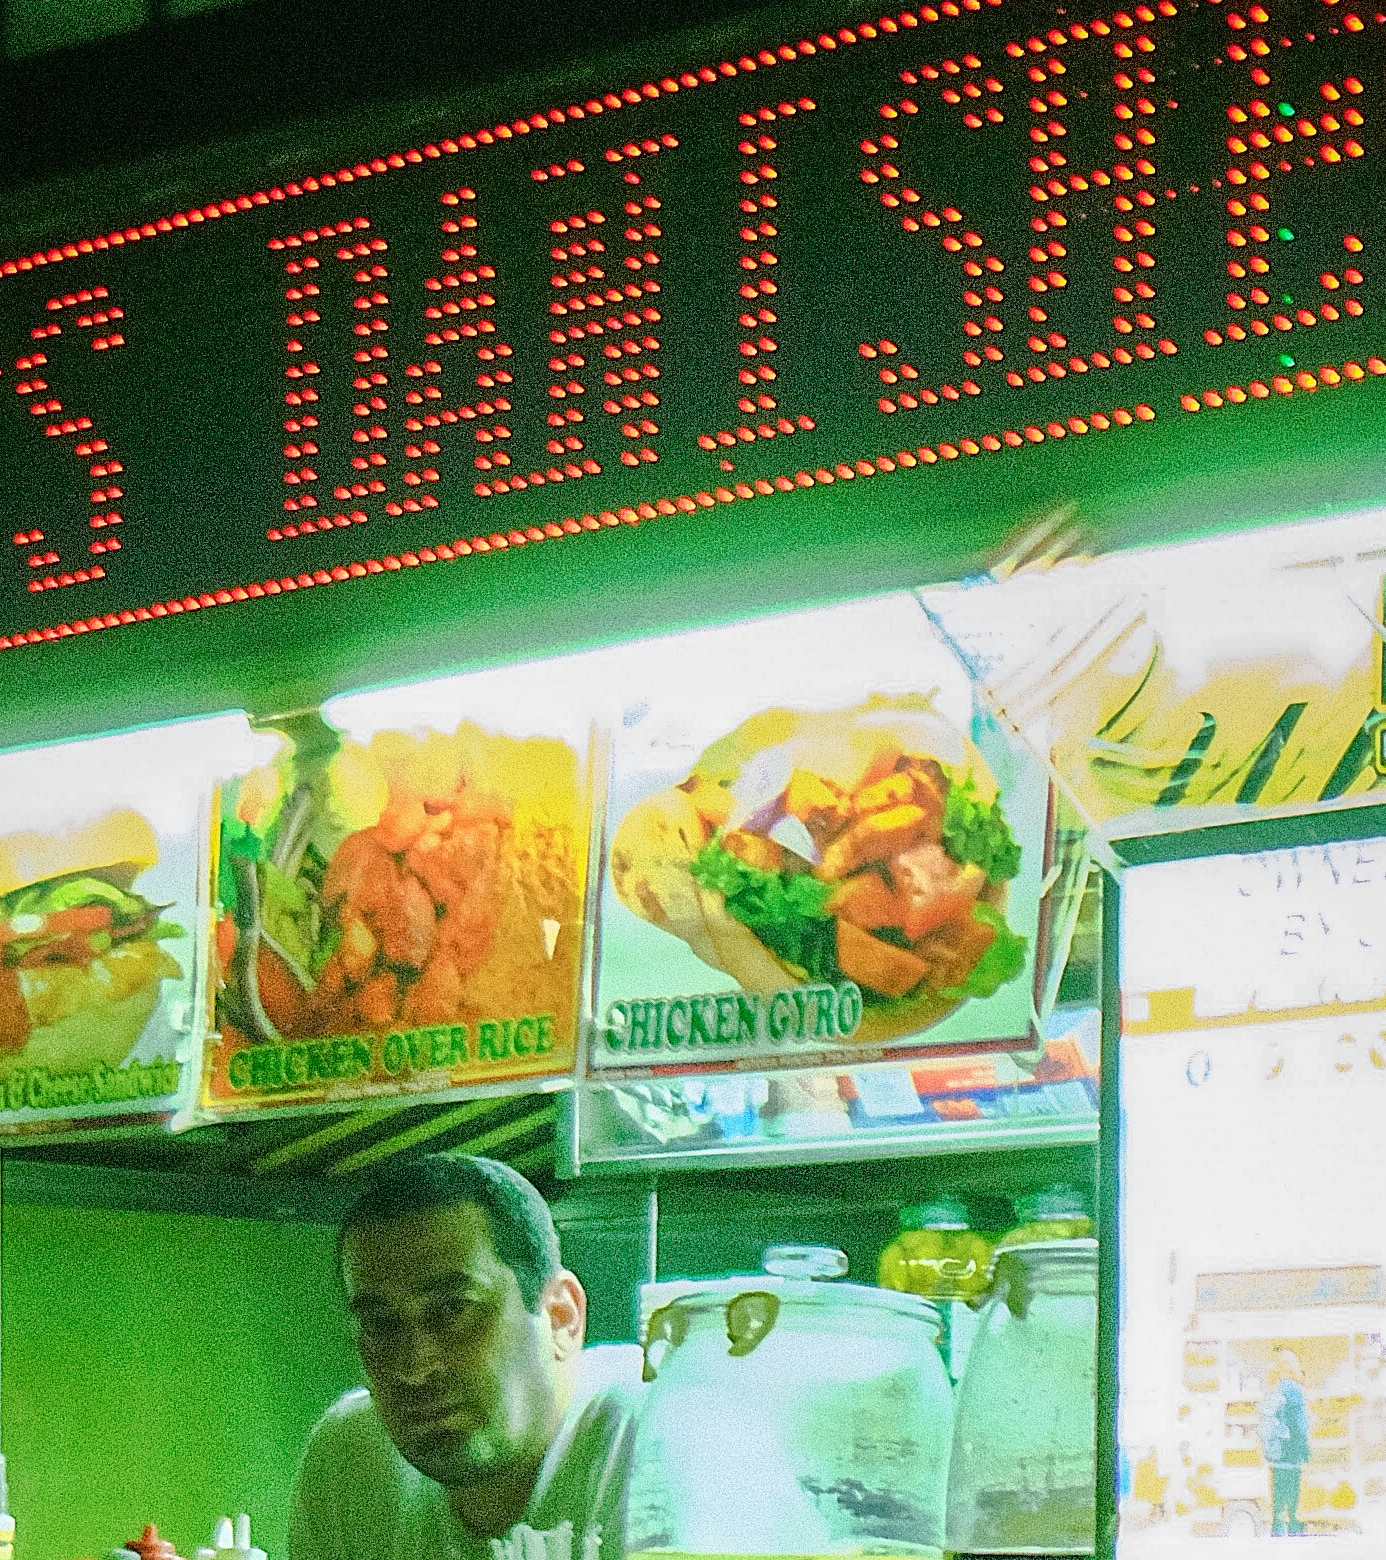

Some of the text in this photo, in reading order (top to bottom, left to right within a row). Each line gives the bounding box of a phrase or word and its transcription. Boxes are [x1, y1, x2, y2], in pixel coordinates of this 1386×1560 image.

[228, 1035, 371, 1090] CHICKEN
[383, 1025, 469, 1074] OVER
[478, 1015, 554, 1059] RICE
[605, 982, 862, 1051] CHICKEN GYRO
